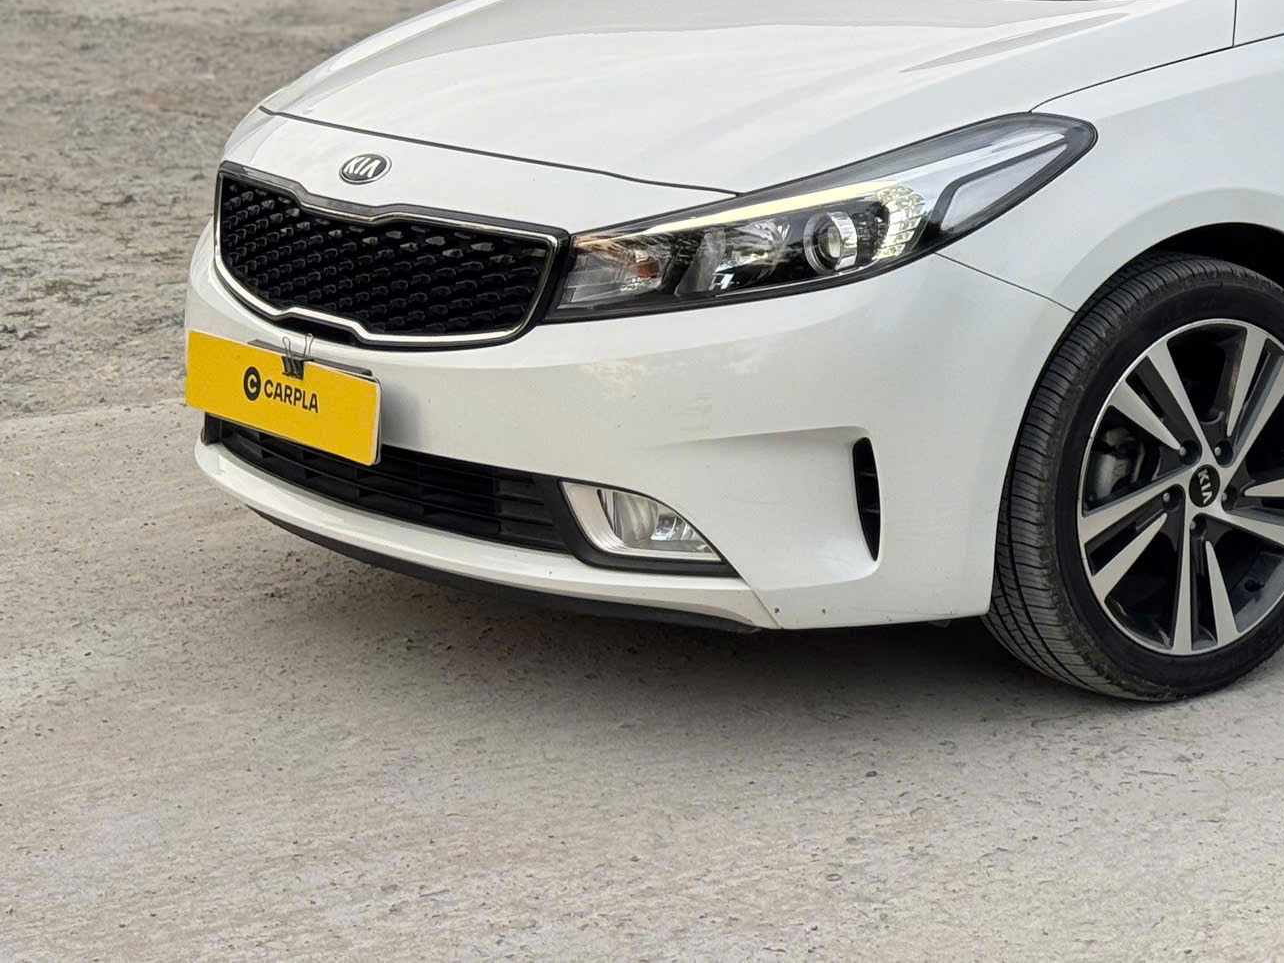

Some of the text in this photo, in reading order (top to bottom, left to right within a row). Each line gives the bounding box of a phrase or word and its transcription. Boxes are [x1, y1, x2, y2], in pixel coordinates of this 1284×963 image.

[343, 156, 382, 178] KIA
[263, 379, 319, 414] CARPLA
[1197, 469, 1212, 504] KIA
